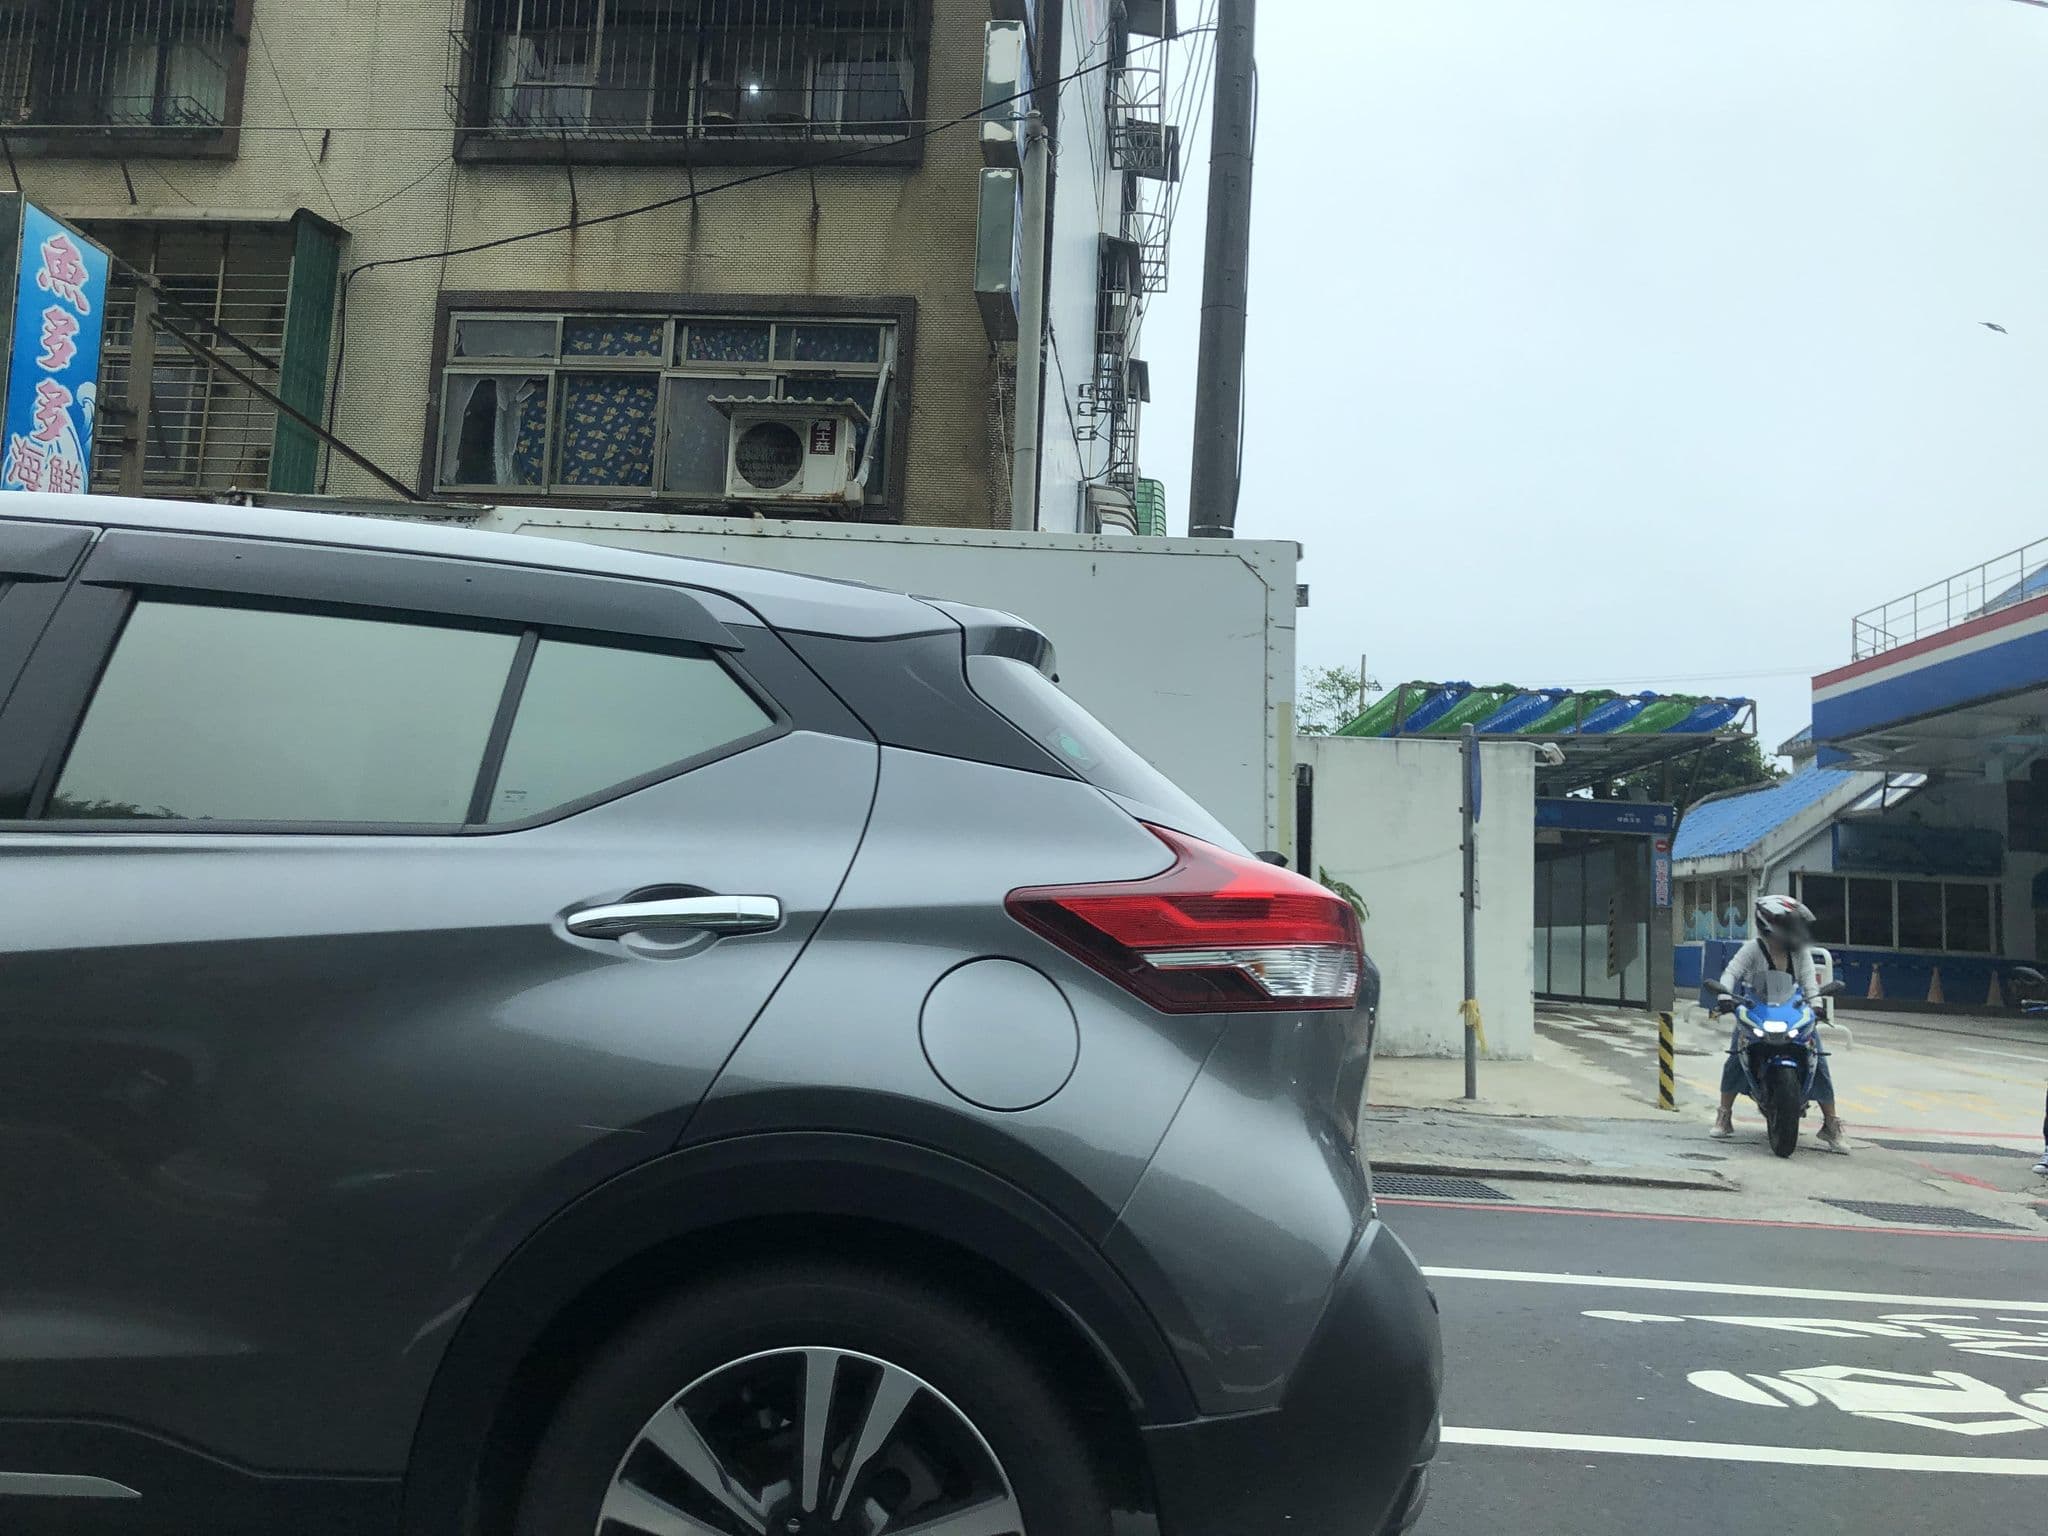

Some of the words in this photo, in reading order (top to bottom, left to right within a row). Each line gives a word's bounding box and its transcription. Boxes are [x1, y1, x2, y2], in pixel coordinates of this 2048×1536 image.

[34, 234, 90, 442] 魚多多
[8, 435, 81, 493] 海鮮
